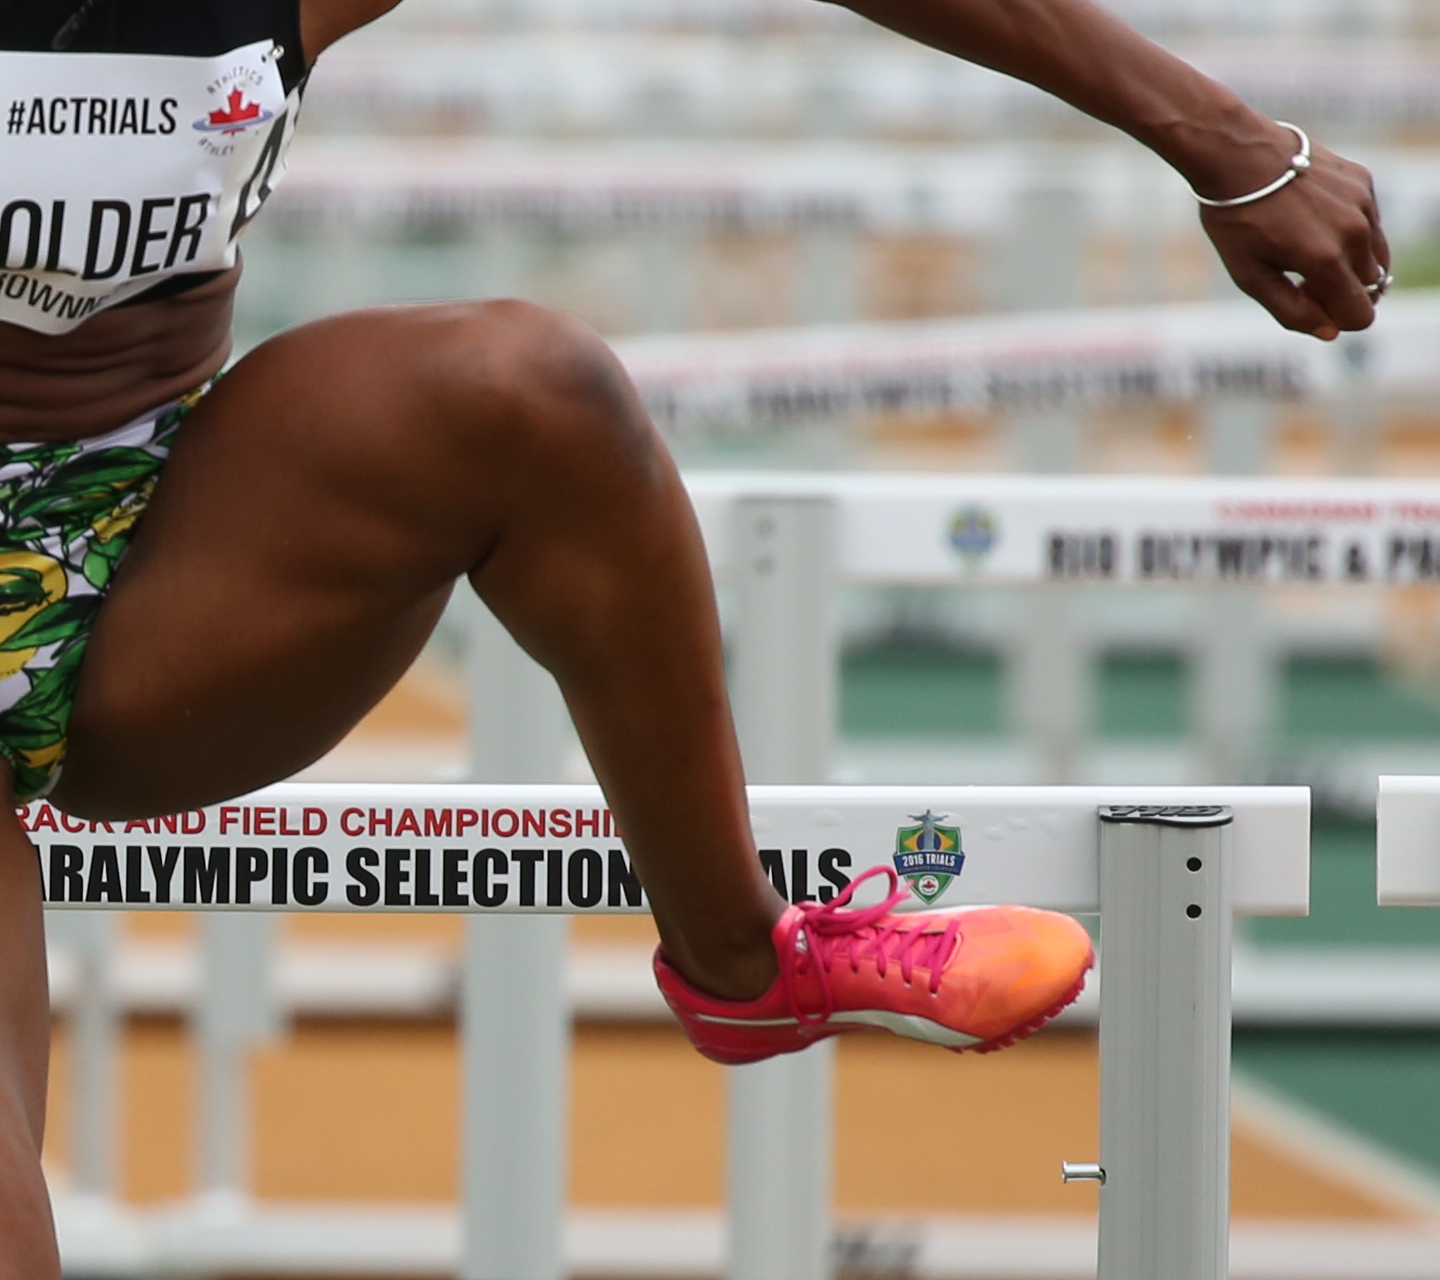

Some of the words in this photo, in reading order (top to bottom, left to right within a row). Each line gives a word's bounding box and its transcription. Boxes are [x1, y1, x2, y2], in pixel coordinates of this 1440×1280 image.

[7, 97, 178, 135] #ACTRIALS
[1138, 533, 1322, 580] OLYMPIC
[220, 806, 327, 835] FIELD
[34, 844, 328, 907] RALYMPIC
[345, 846, 642, 907] SELECTION
[925, 854, 957, 867] TRIALS
